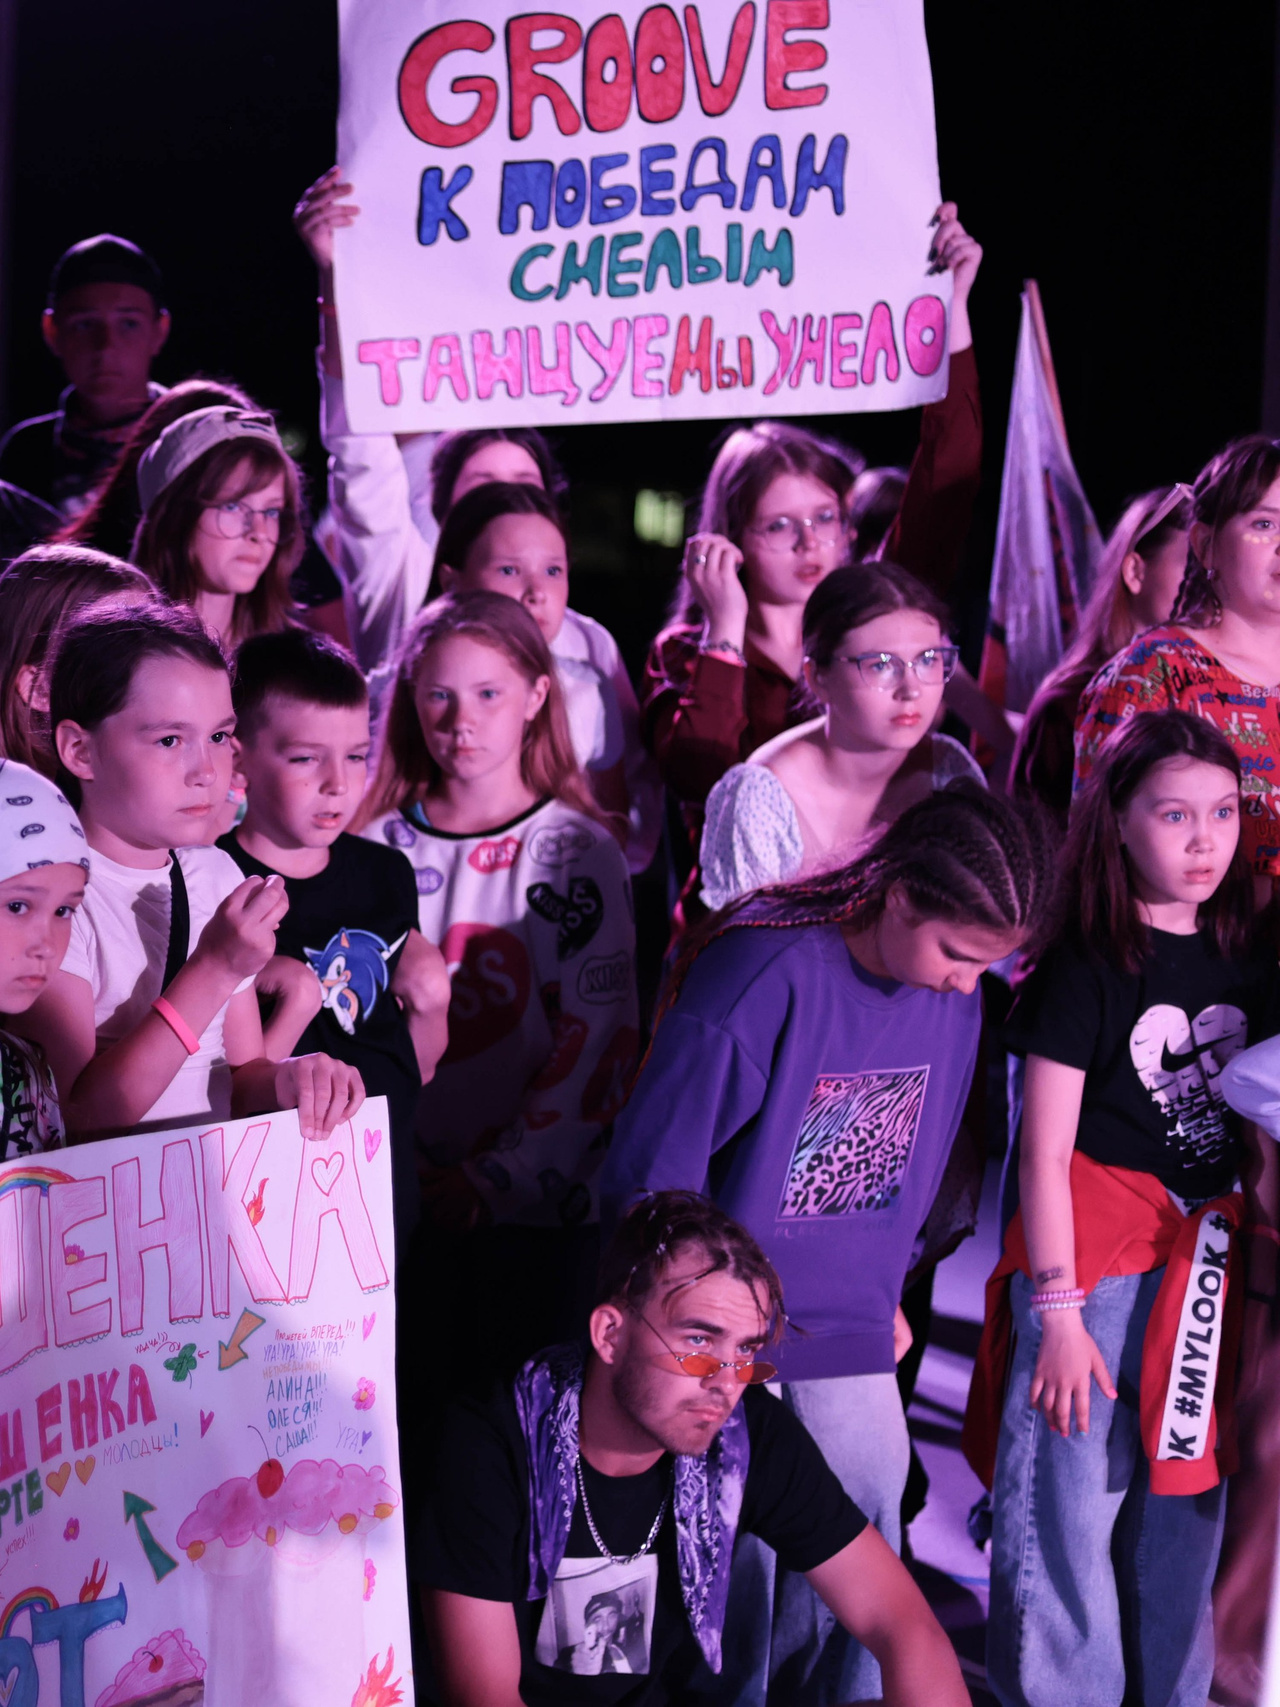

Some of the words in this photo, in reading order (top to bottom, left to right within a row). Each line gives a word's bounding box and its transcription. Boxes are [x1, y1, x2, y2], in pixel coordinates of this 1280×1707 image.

[397, 0, 831, 148] GROOVE
[417, 165, 473, 245] К
[499, 133, 849, 235] ПОБЕДАМ
[510, 223, 795, 301] СМЕЛЫМ
[1174, 1242, 1228, 1418] #MYLOOK
[1167, 1427, 1197, 1460] K
